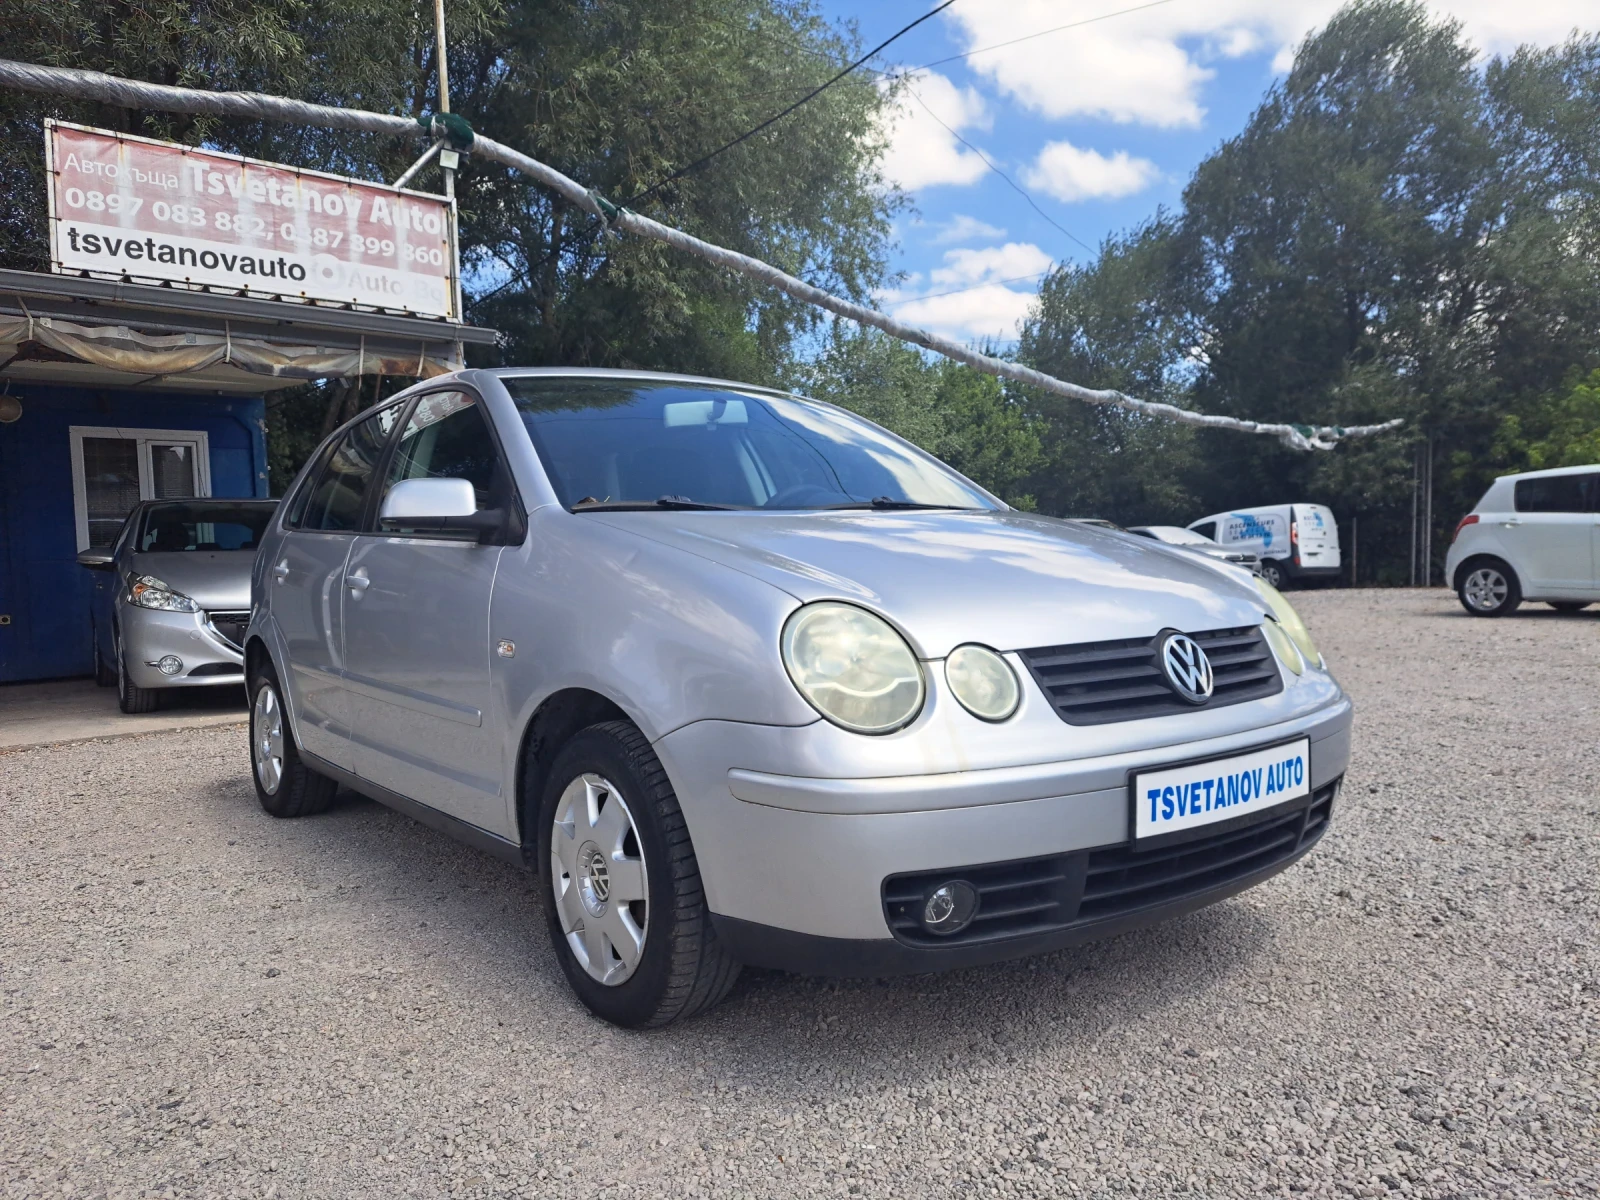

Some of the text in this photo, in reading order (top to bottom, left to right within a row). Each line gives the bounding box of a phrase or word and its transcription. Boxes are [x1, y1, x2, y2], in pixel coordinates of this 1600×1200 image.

[65, 187, 143, 216] 0897
[152, 201, 207, 227] 083
[187, 161, 362, 218] Tsvetanov
[370, 195, 441, 234] Auto
[67, 227, 306, 281] tsvetanovauto
[1147, 756, 1303, 822] TSVETANOV AUTO
